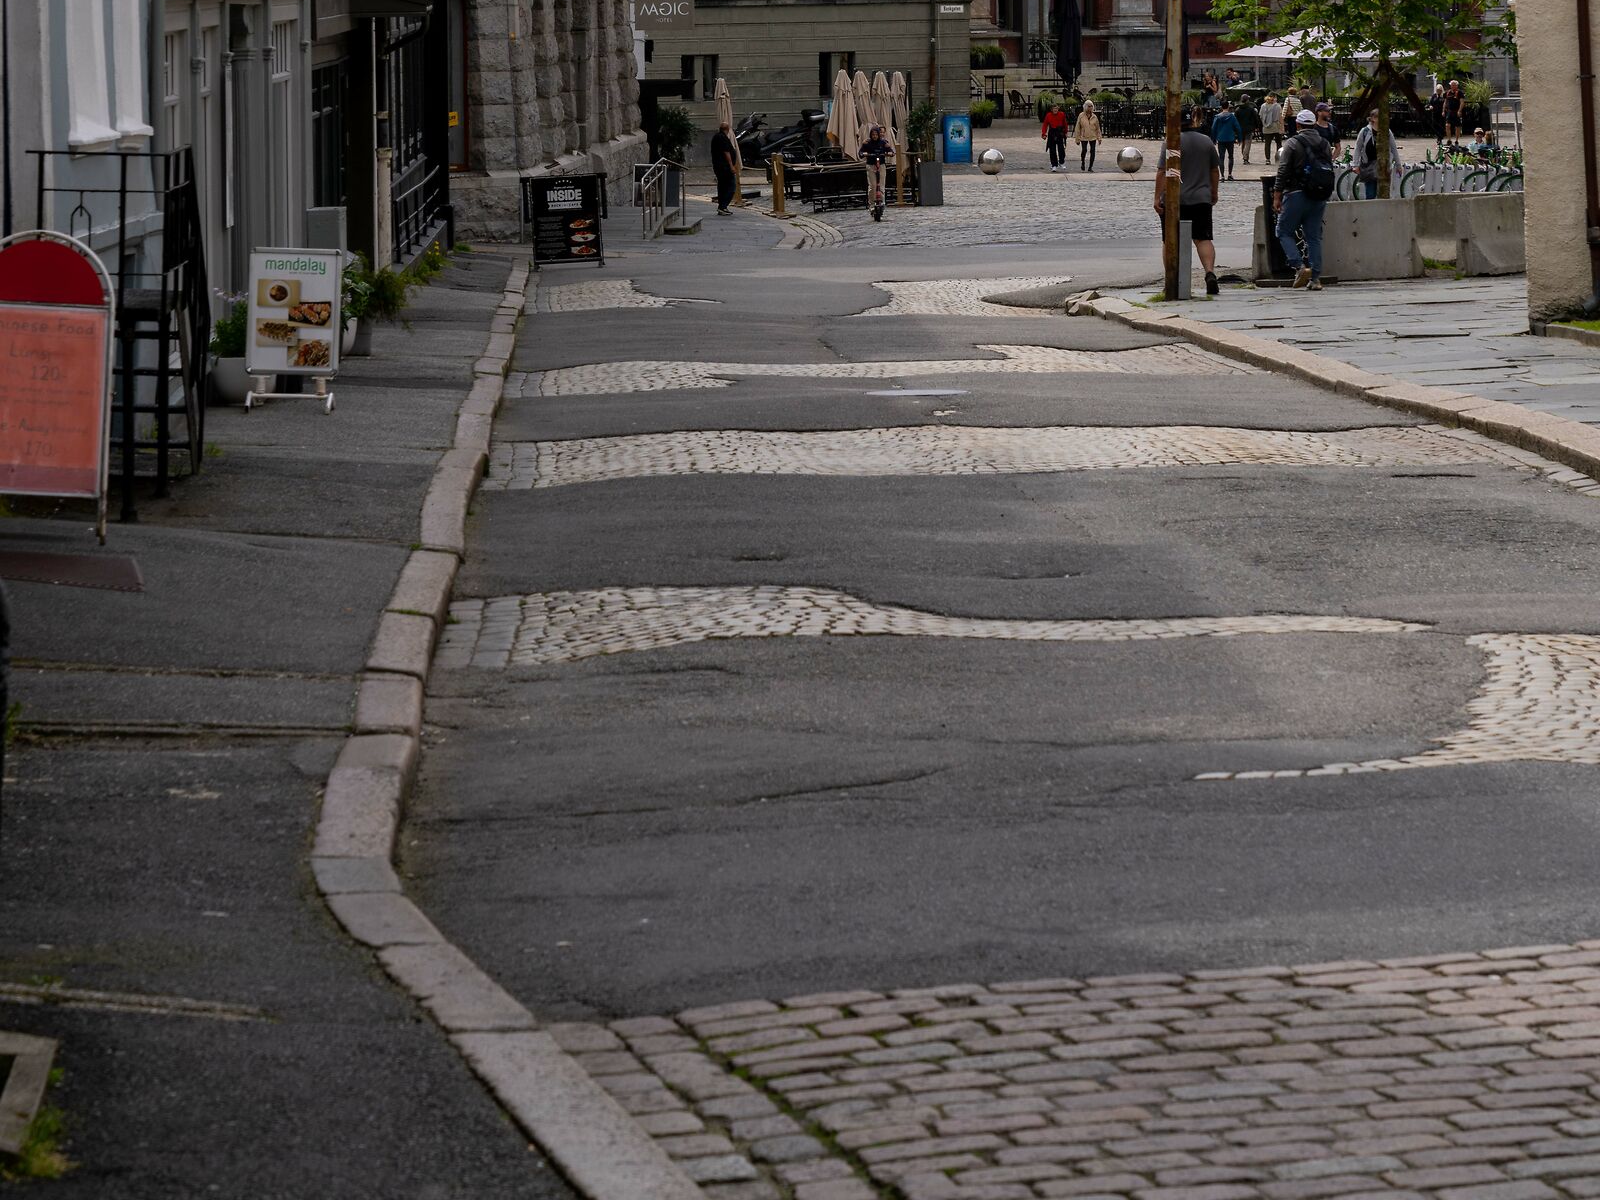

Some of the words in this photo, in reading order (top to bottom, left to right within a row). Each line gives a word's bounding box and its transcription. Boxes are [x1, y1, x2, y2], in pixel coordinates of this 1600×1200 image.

[640, 2, 689, 16] MAGIC
[547, 189, 582, 201] INSIDE
[265, 258, 326, 275] mandalay
[58, 318, 95, 335] Food
